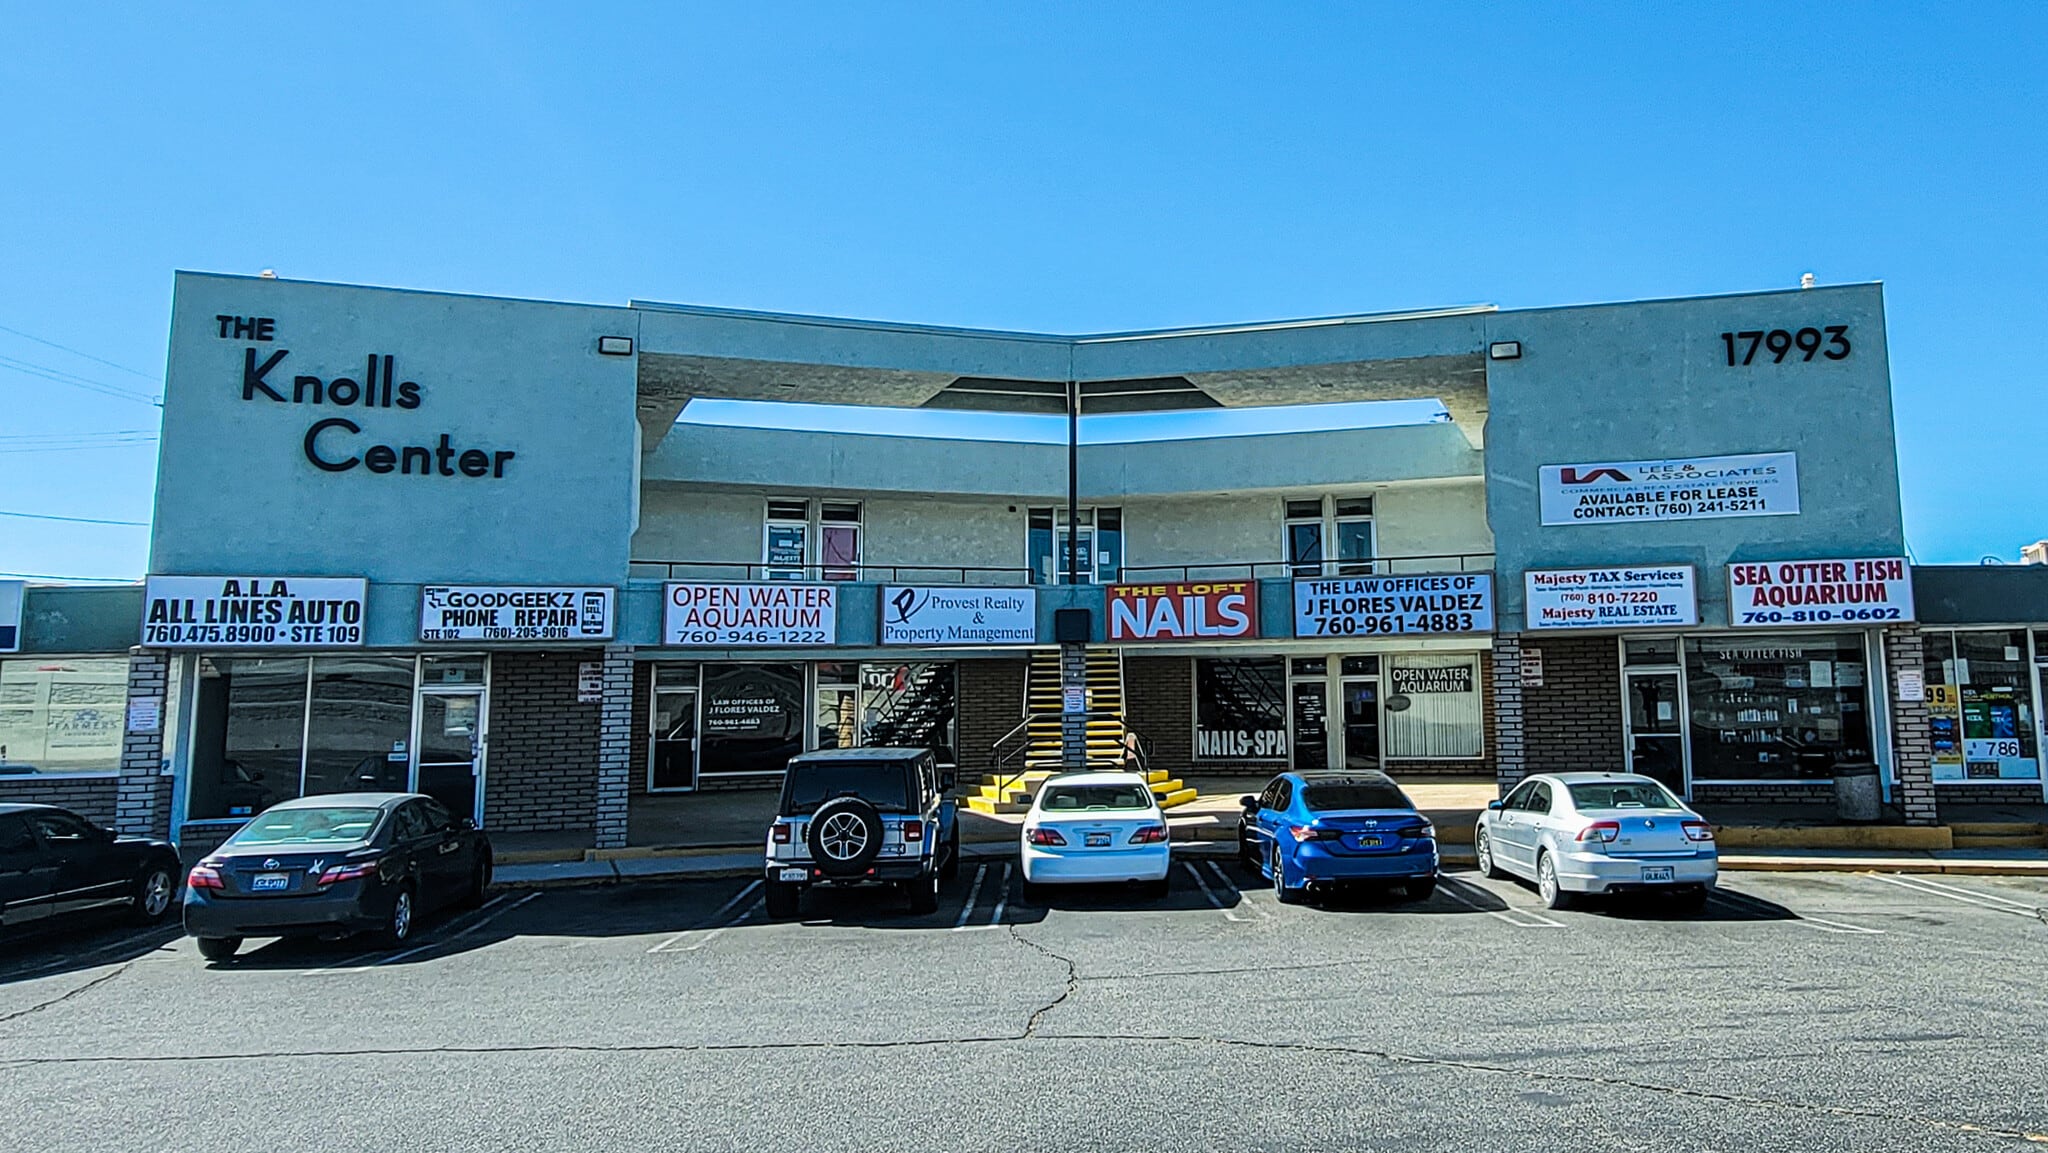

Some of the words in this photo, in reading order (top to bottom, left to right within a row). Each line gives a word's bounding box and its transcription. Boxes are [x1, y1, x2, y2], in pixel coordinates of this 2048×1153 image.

[216, 314, 275, 341] THE
[1721, 325, 1851, 367] 17993
[242, 347, 421, 409] Knolls
[304, 417, 516, 478] Center
[1639, 465, 1674, 474] LEE
[1646, 466, 1777, 481] ASSOCIATES
[1579, 493, 1665, 506] AVAILABLE
[1670, 490, 1702, 501] FOR
[1707, 486, 1759, 499] LEASE
[1573, 505, 1650, 519] CONTACT:
[1654, 502, 1692, 517] (760)
[1697, 499, 1767, 513] 241-5211
[1534, 574, 1587, 586] Majesty
[1589, 571, 1621, 582] TAX
[1624, 570, 1684, 581] Services
[1734, 564, 1772, 585] SEA
[1779, 562, 1847, 584] OTTER
[1854, 560, 1903, 582] FISH
[222, 580, 296, 597] A.L.A.
[1114, 587, 1167, 597] THE
[1177, 584, 1247, 595] LOFT
[1310, 582, 1341, 595] THE
[1345, 580, 1379, 594] LAW
[1383, 577, 1449, 592] OFFICES
[1453, 576, 1475, 589] OF
[447, 592, 575, 608] GOODGEEKZ
[673, 587, 740, 606] OPEN
[749, 588, 832, 608] WATER
[1560, 593, 1584, 602] (760)
[1588, 591, 1658, 604] 810-7220
[1752, 583, 1888, 607] AQUARIUM
[148, 599, 197, 623] ALL
[204, 600, 282, 624] LINES
[287, 600, 360, 624] AUTO
[932, 597, 979, 609] Provest
[984, 597, 1025, 614] Realty
[1305, 600, 1313, 615] J
[1319, 597, 1395, 614] FLORES
[1400, 594, 1483, 612] VALDEZ
[1542, 608, 1595, 620] Majesty
[1599, 605, 1630, 617] REAL
[1633, 604, 1678, 616] ESTATE
[442, 610, 498, 627] PHONE
[515, 610, 577, 627] REPAIR
[684, 609, 820, 630] AQUARIUM
[972, 612, 985, 624] &
[1111, 595, 1250, 639] NAILS
[1742, 608, 1900, 623] 760-810-0602
[423, 629, 440, 639] STE
[443, 629, 460, 639] 102
[483, 627, 568, 638] (760)-205-9016
[1314, 614, 1473, 635] 760-961-4883
[146, 625, 275, 643] 760.475.8900
[290, 627, 323, 643] STE
[326, 627, 360, 643] 109
[677, 631, 826, 643] 760-946-1222
[885, 626, 944, 642] Property
[948, 627, 1034, 640] Management
[1720, 649, 1739, 660] SEA
[1779, 648, 1802, 658] FISH
[1393, 669, 1425, 681] OPEN
[1429, 668, 1469, 680] WATER
[1399, 680, 1465, 693] AQUARIUM
